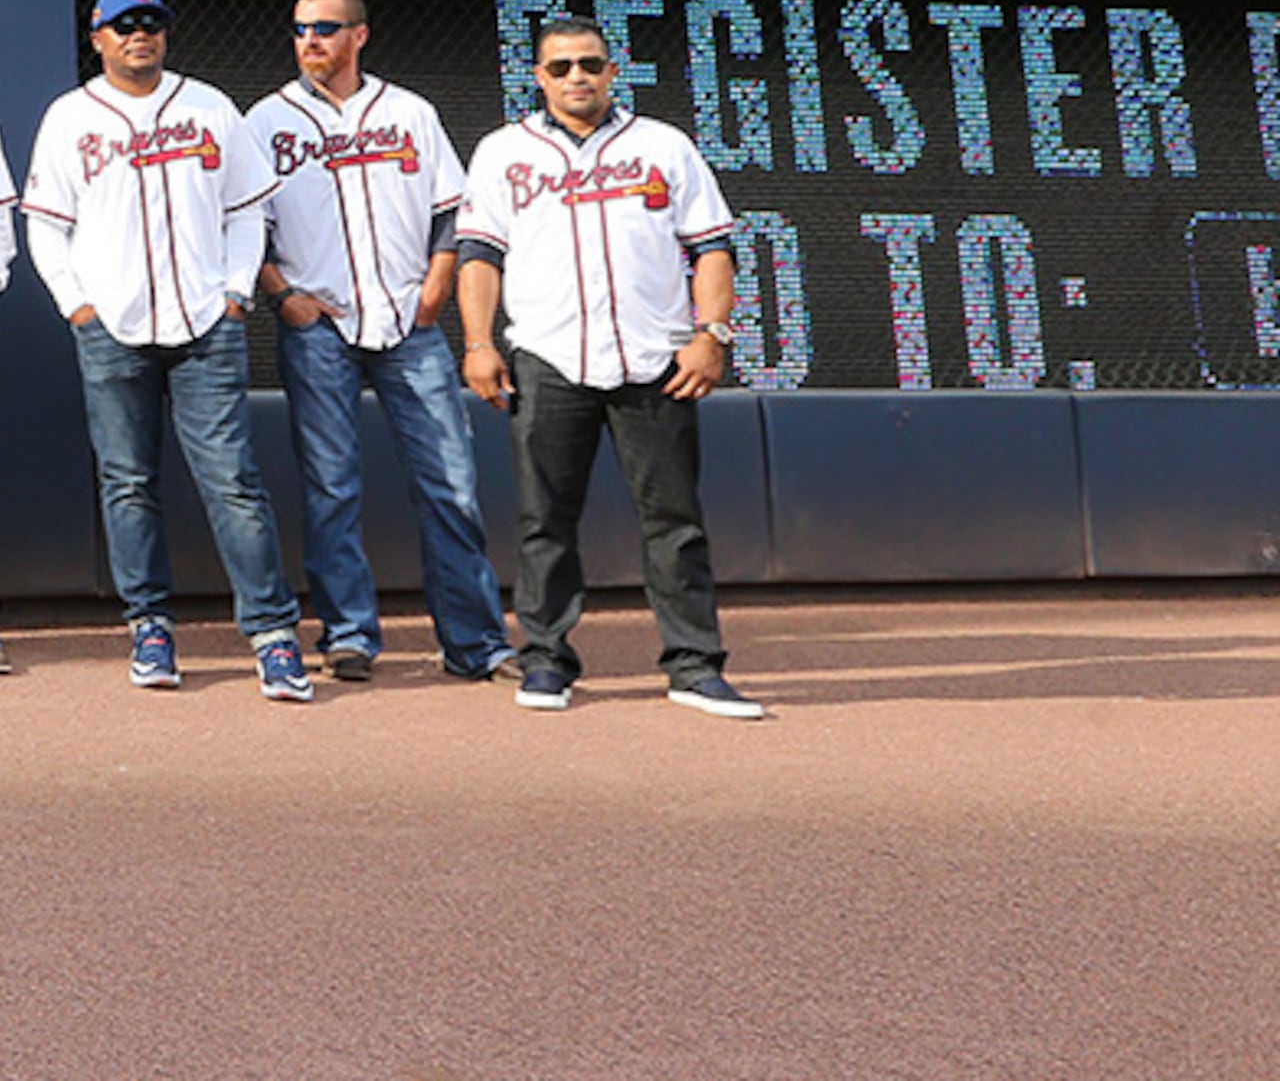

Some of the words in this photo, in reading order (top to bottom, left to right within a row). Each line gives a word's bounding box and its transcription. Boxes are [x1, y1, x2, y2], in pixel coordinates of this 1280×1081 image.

[78, 118, 198, 185] Braves
[272, 124, 398, 176] Braves
[505, 157, 643, 216] Braves
[690, 210, 814, 390] O
[860, 213, 1096, 391] TO:
